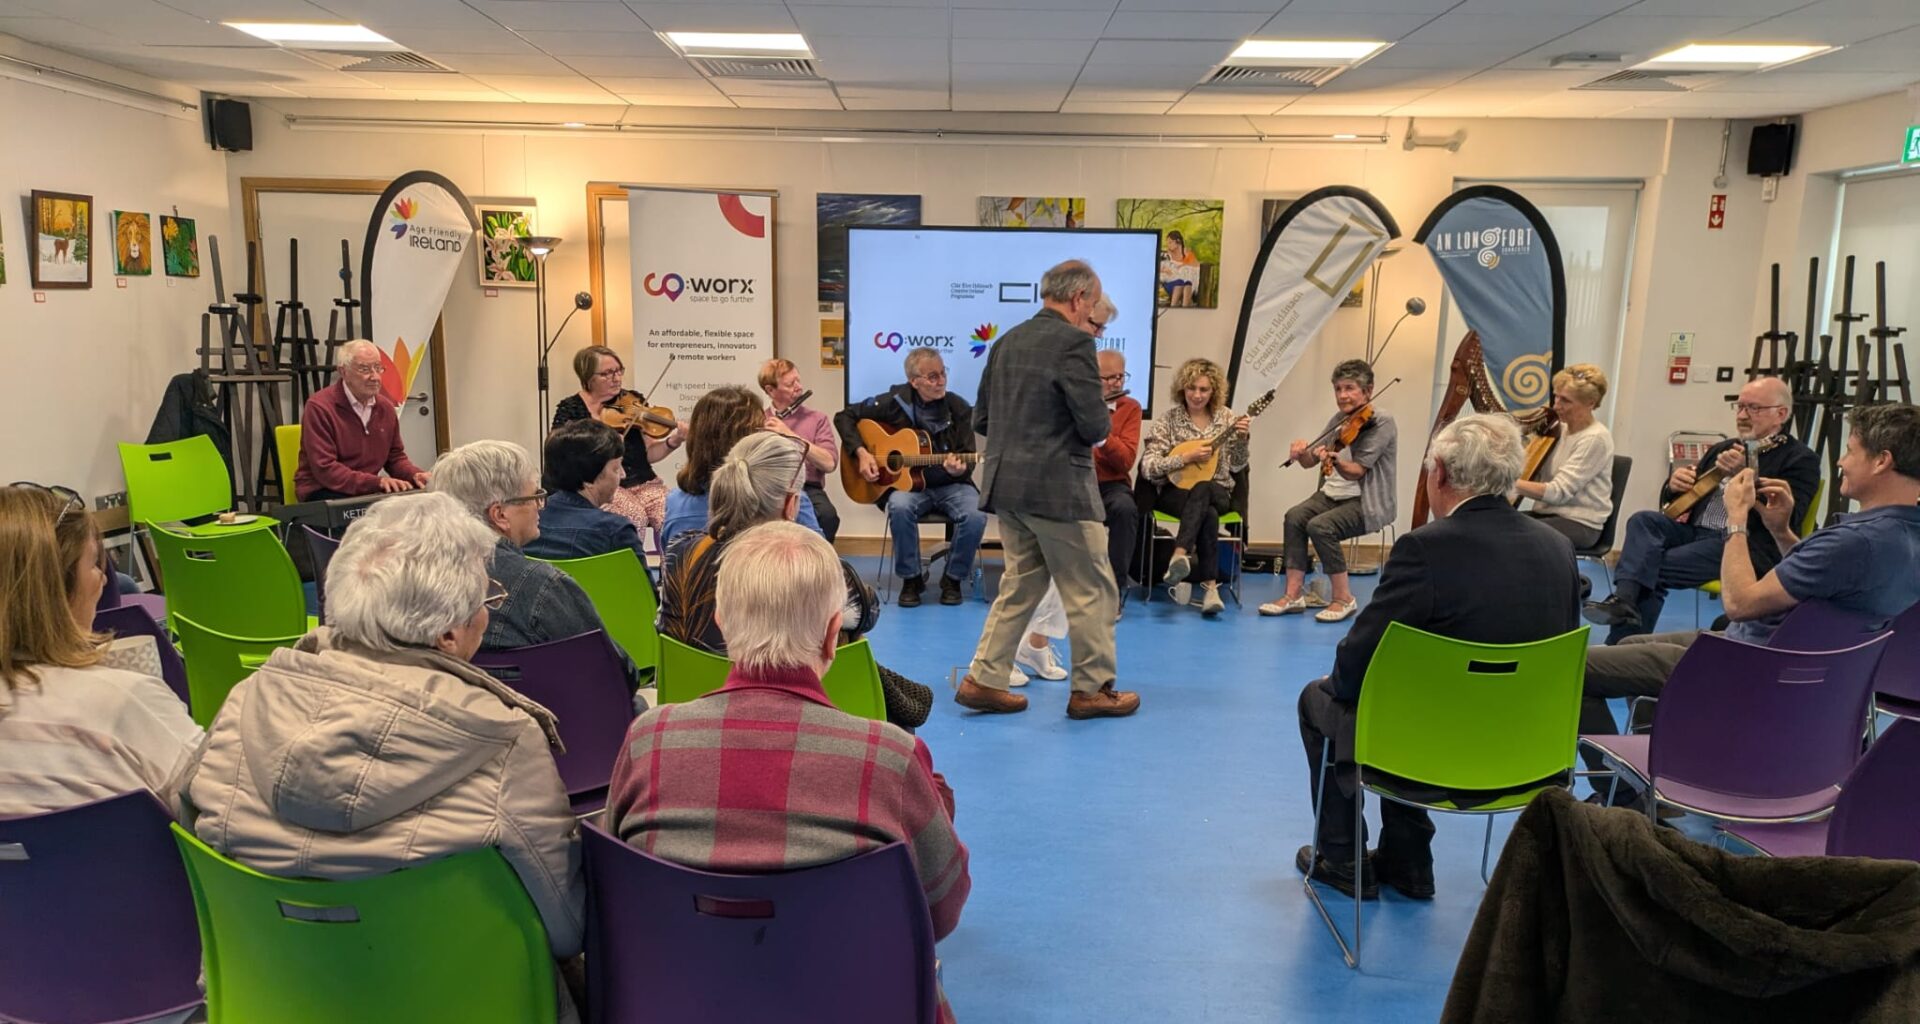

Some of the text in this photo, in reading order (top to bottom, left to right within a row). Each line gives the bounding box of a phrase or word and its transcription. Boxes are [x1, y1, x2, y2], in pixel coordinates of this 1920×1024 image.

[409, 224, 462, 239] Age Friendly
[1436, 232, 1452, 251] AN
[690, 295, 709, 303] space
[720, 296, 729, 304] go
[730, 295, 754, 303] further
[649, 329, 755, 339] An affordable, flexible space
[660, 342, 716, 350] entrepreneurs,
[717, 342, 757, 350] innovators
[706, 353, 736, 361] workers
[666, 383, 682, 391] High
[684, 383, 706, 391] speed
